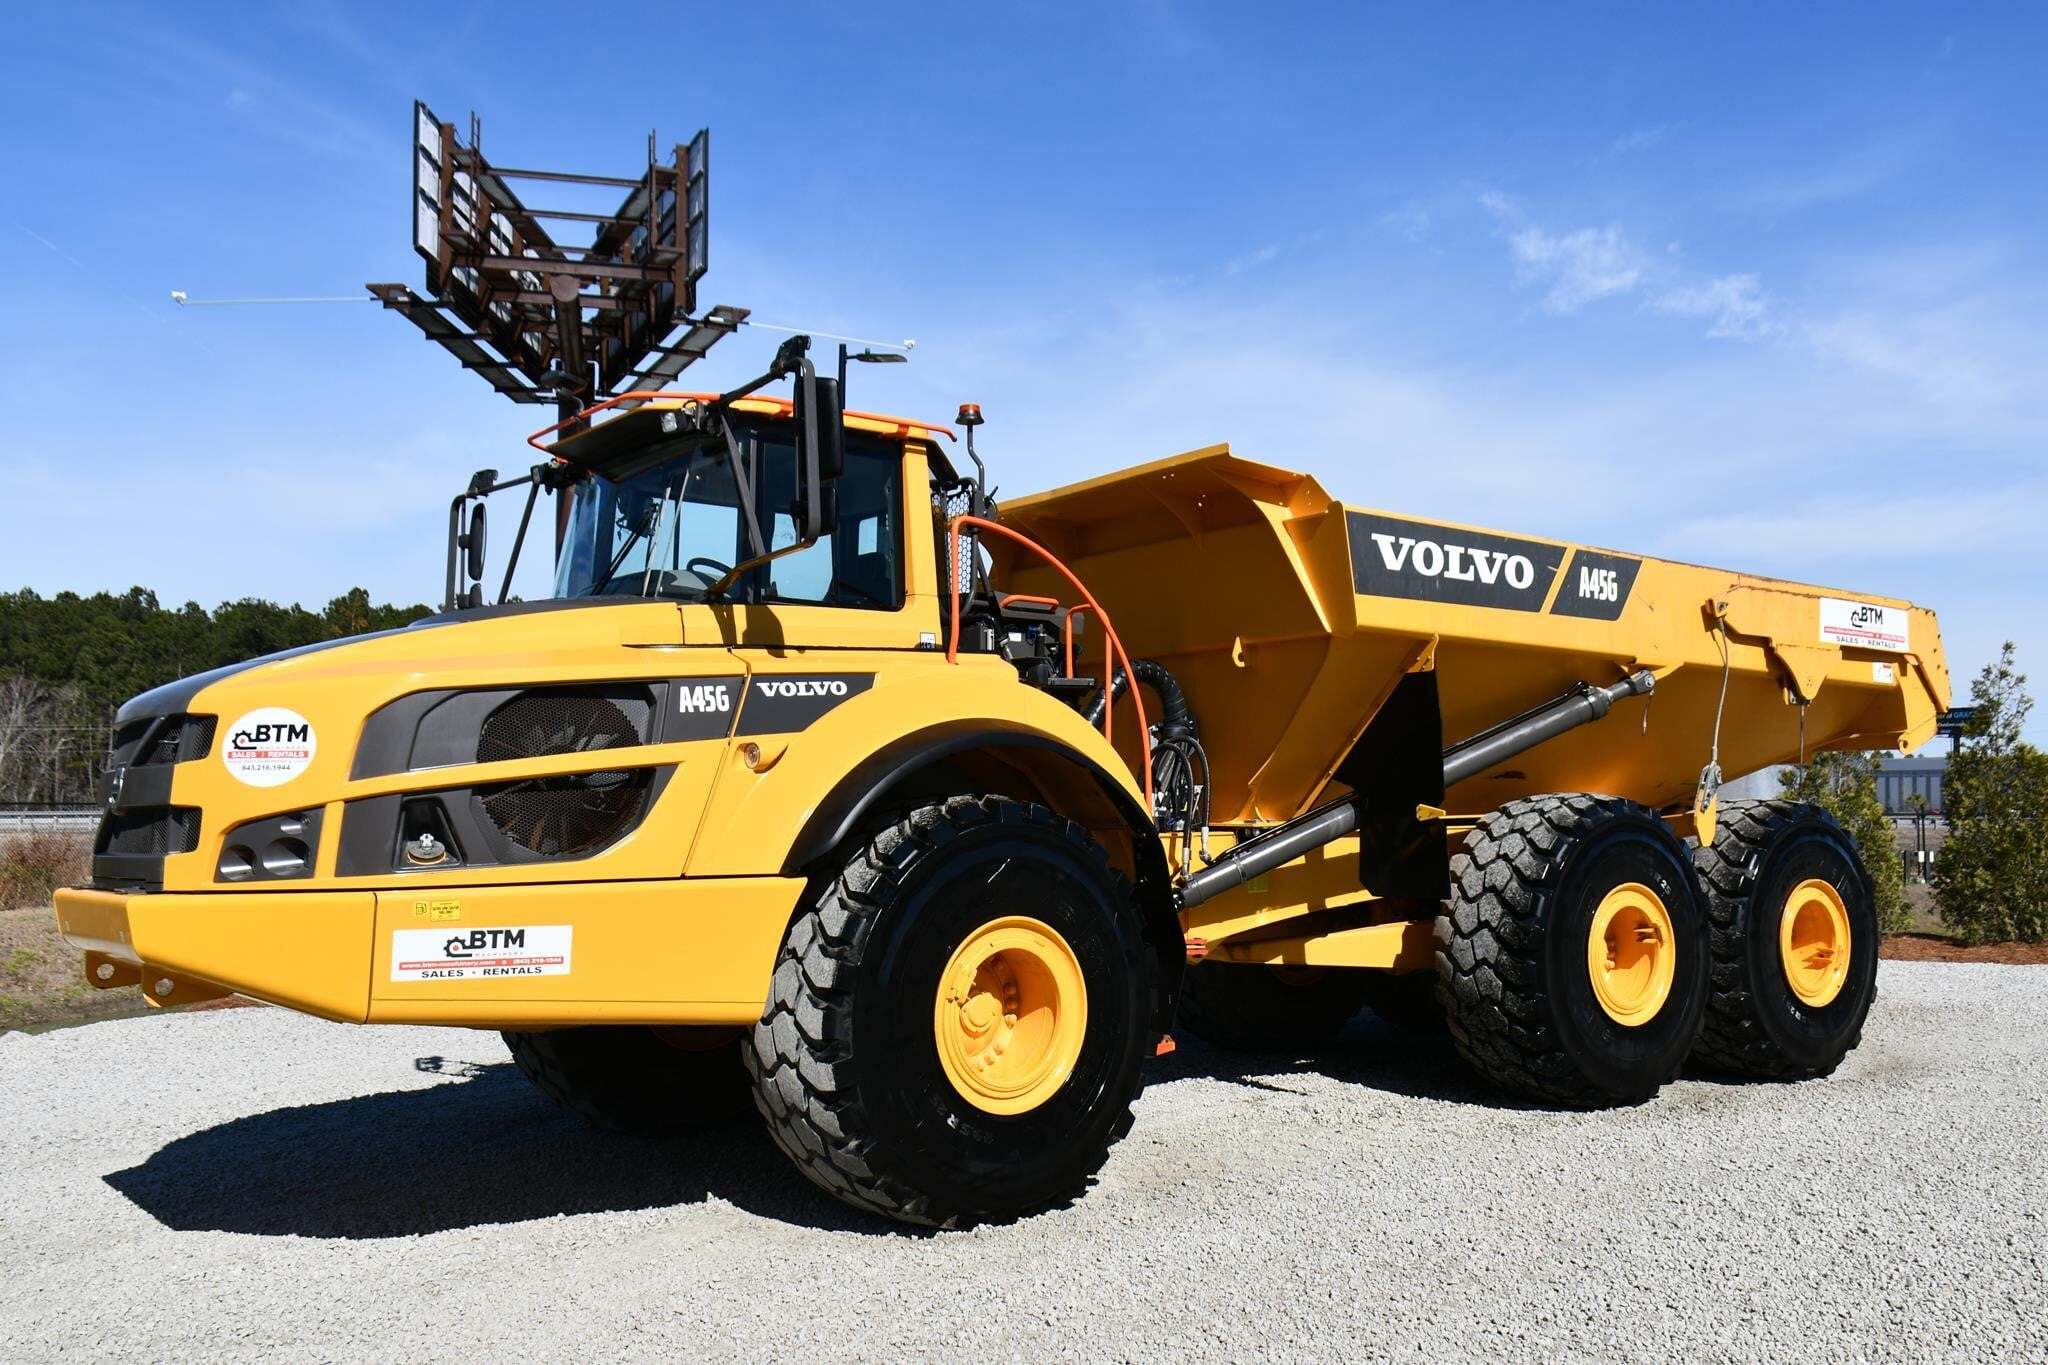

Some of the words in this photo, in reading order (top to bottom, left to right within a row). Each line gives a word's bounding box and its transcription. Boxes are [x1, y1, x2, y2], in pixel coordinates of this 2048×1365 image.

[1371, 533, 1535, 590] VOLVO
[1579, 566, 1618, 602] A45G
[1861, 606, 1883, 625] BTM
[1836, 635, 1859, 644] SALES
[1867, 639, 1897, 649] RENTALS
[679, 685, 730, 713] A45G
[756, 680, 848, 697] VOLVO
[256, 724, 309, 743] BTM
[469, 929, 525, 950] BTM
[421, 969, 464, 979] SALES
[483, 966, 542, 976] RENTALS
